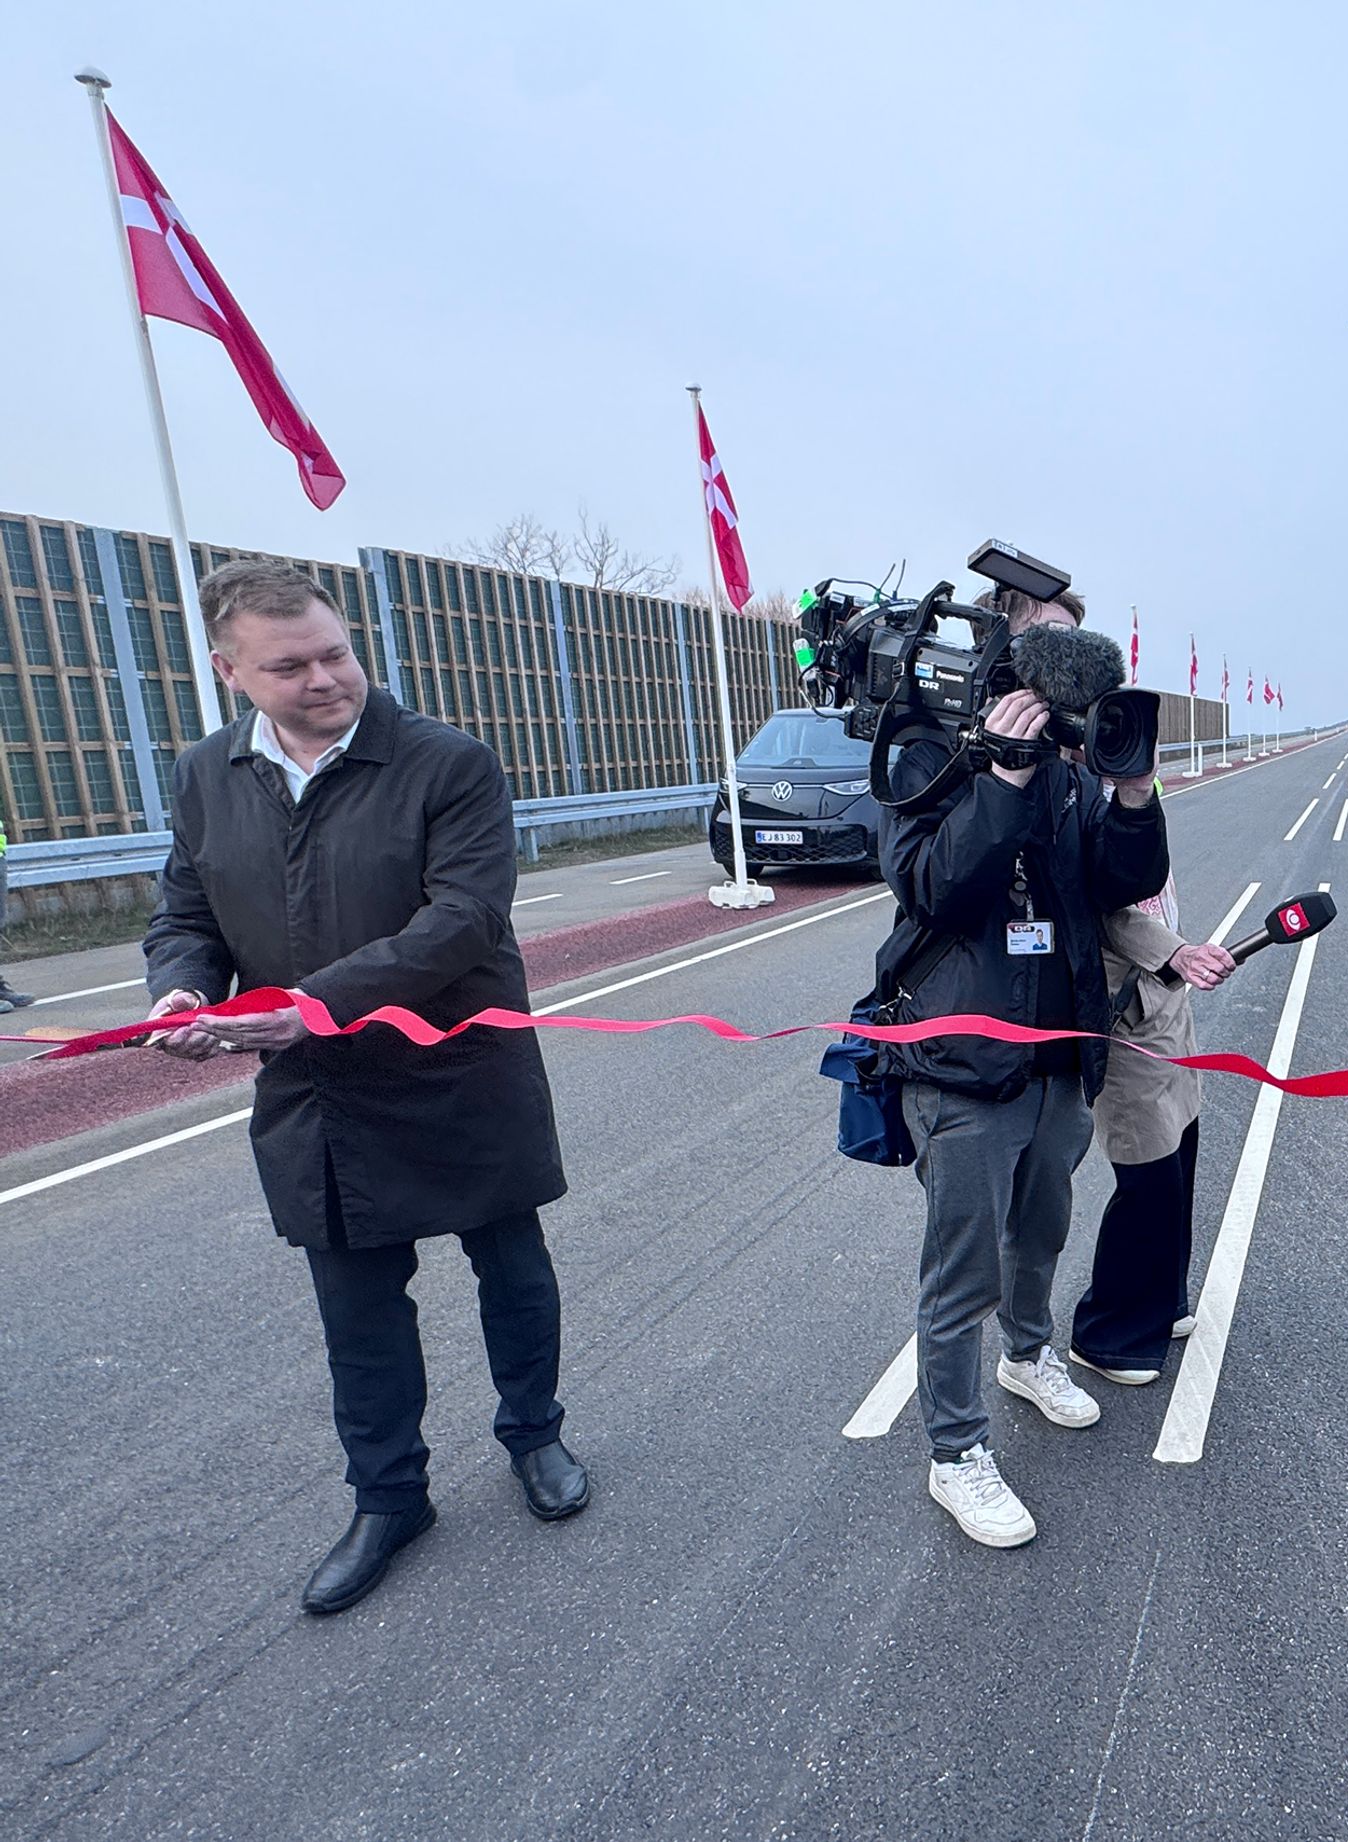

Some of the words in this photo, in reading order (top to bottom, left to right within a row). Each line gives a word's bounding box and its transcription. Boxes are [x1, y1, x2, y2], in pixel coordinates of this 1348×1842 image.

[936, 670, 964, 683] Panasonic
[919, 679, 940, 690] DR
[786, 833, 800, 842] 302
